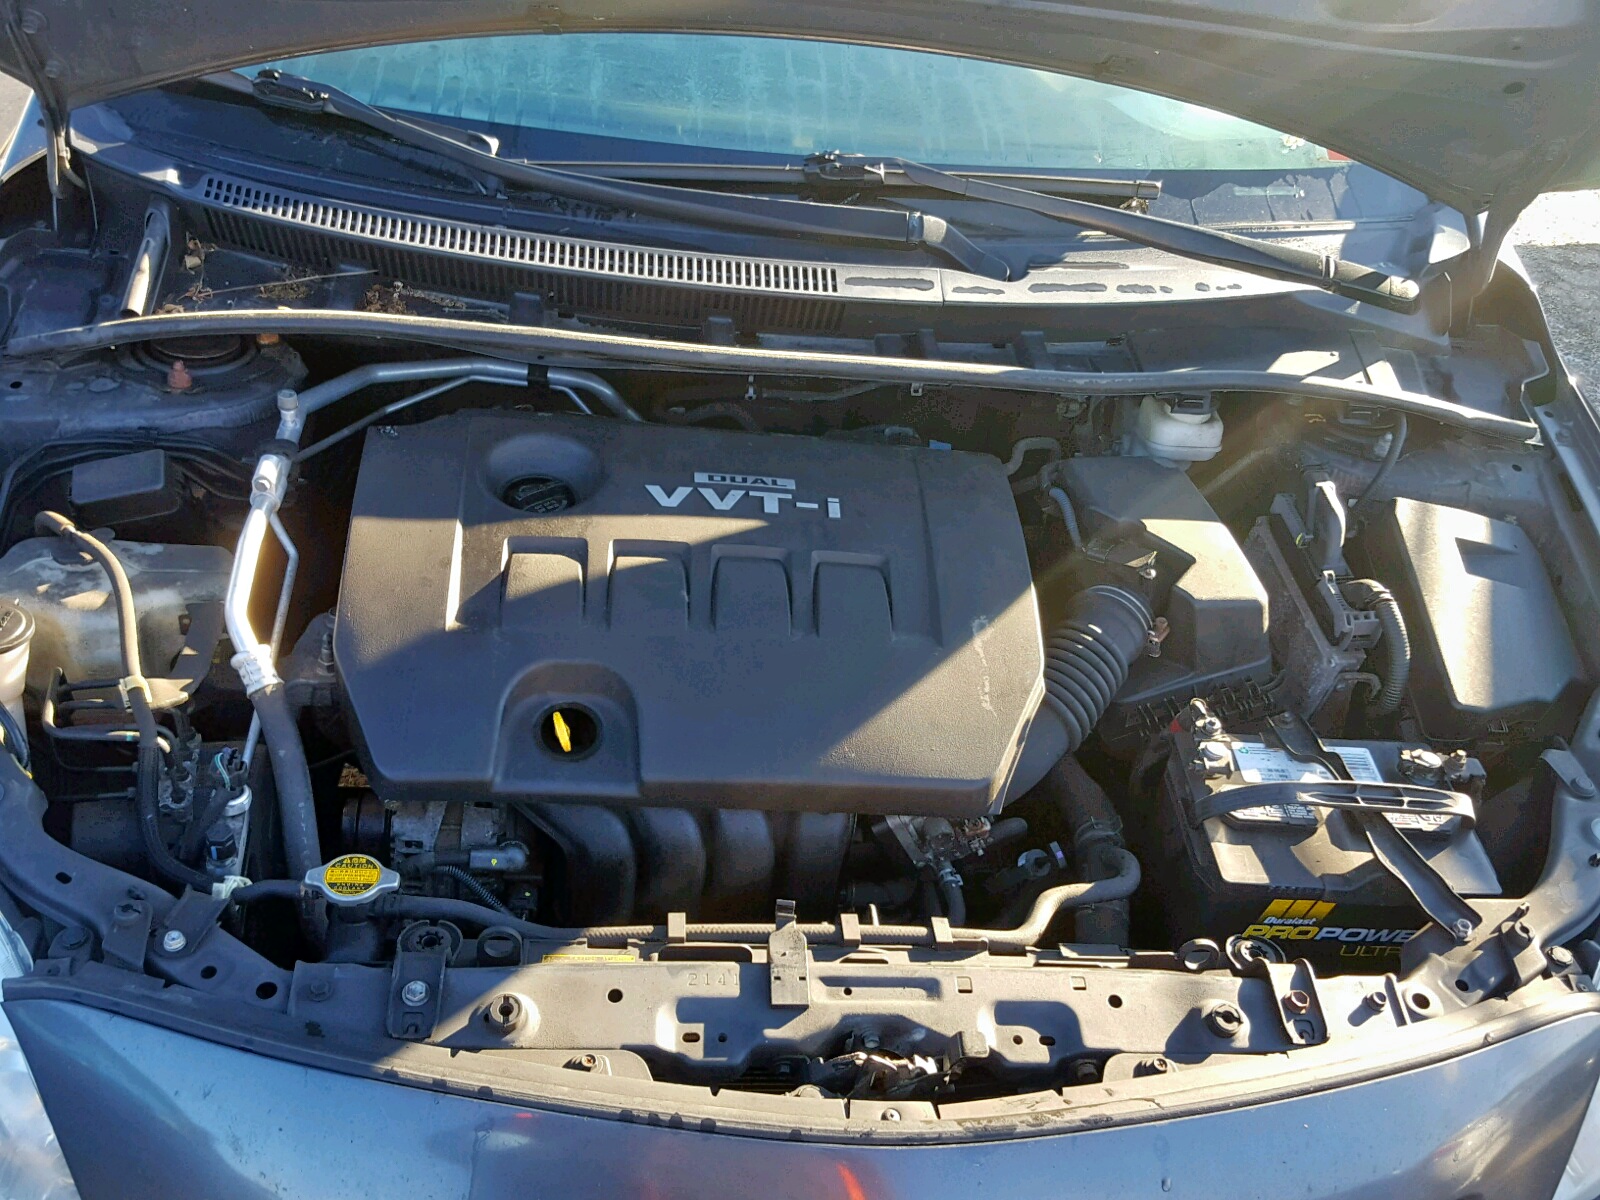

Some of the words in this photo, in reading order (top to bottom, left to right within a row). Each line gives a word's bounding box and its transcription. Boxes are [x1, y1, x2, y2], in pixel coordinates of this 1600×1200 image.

[708, 474, 788, 486] DUAL
[644, 484, 842, 519] VVT-i
[1263, 916, 1317, 926] Duralast
[1241, 925, 1418, 942] PROPOWE
[1340, 945, 1402, 957] ULTR
